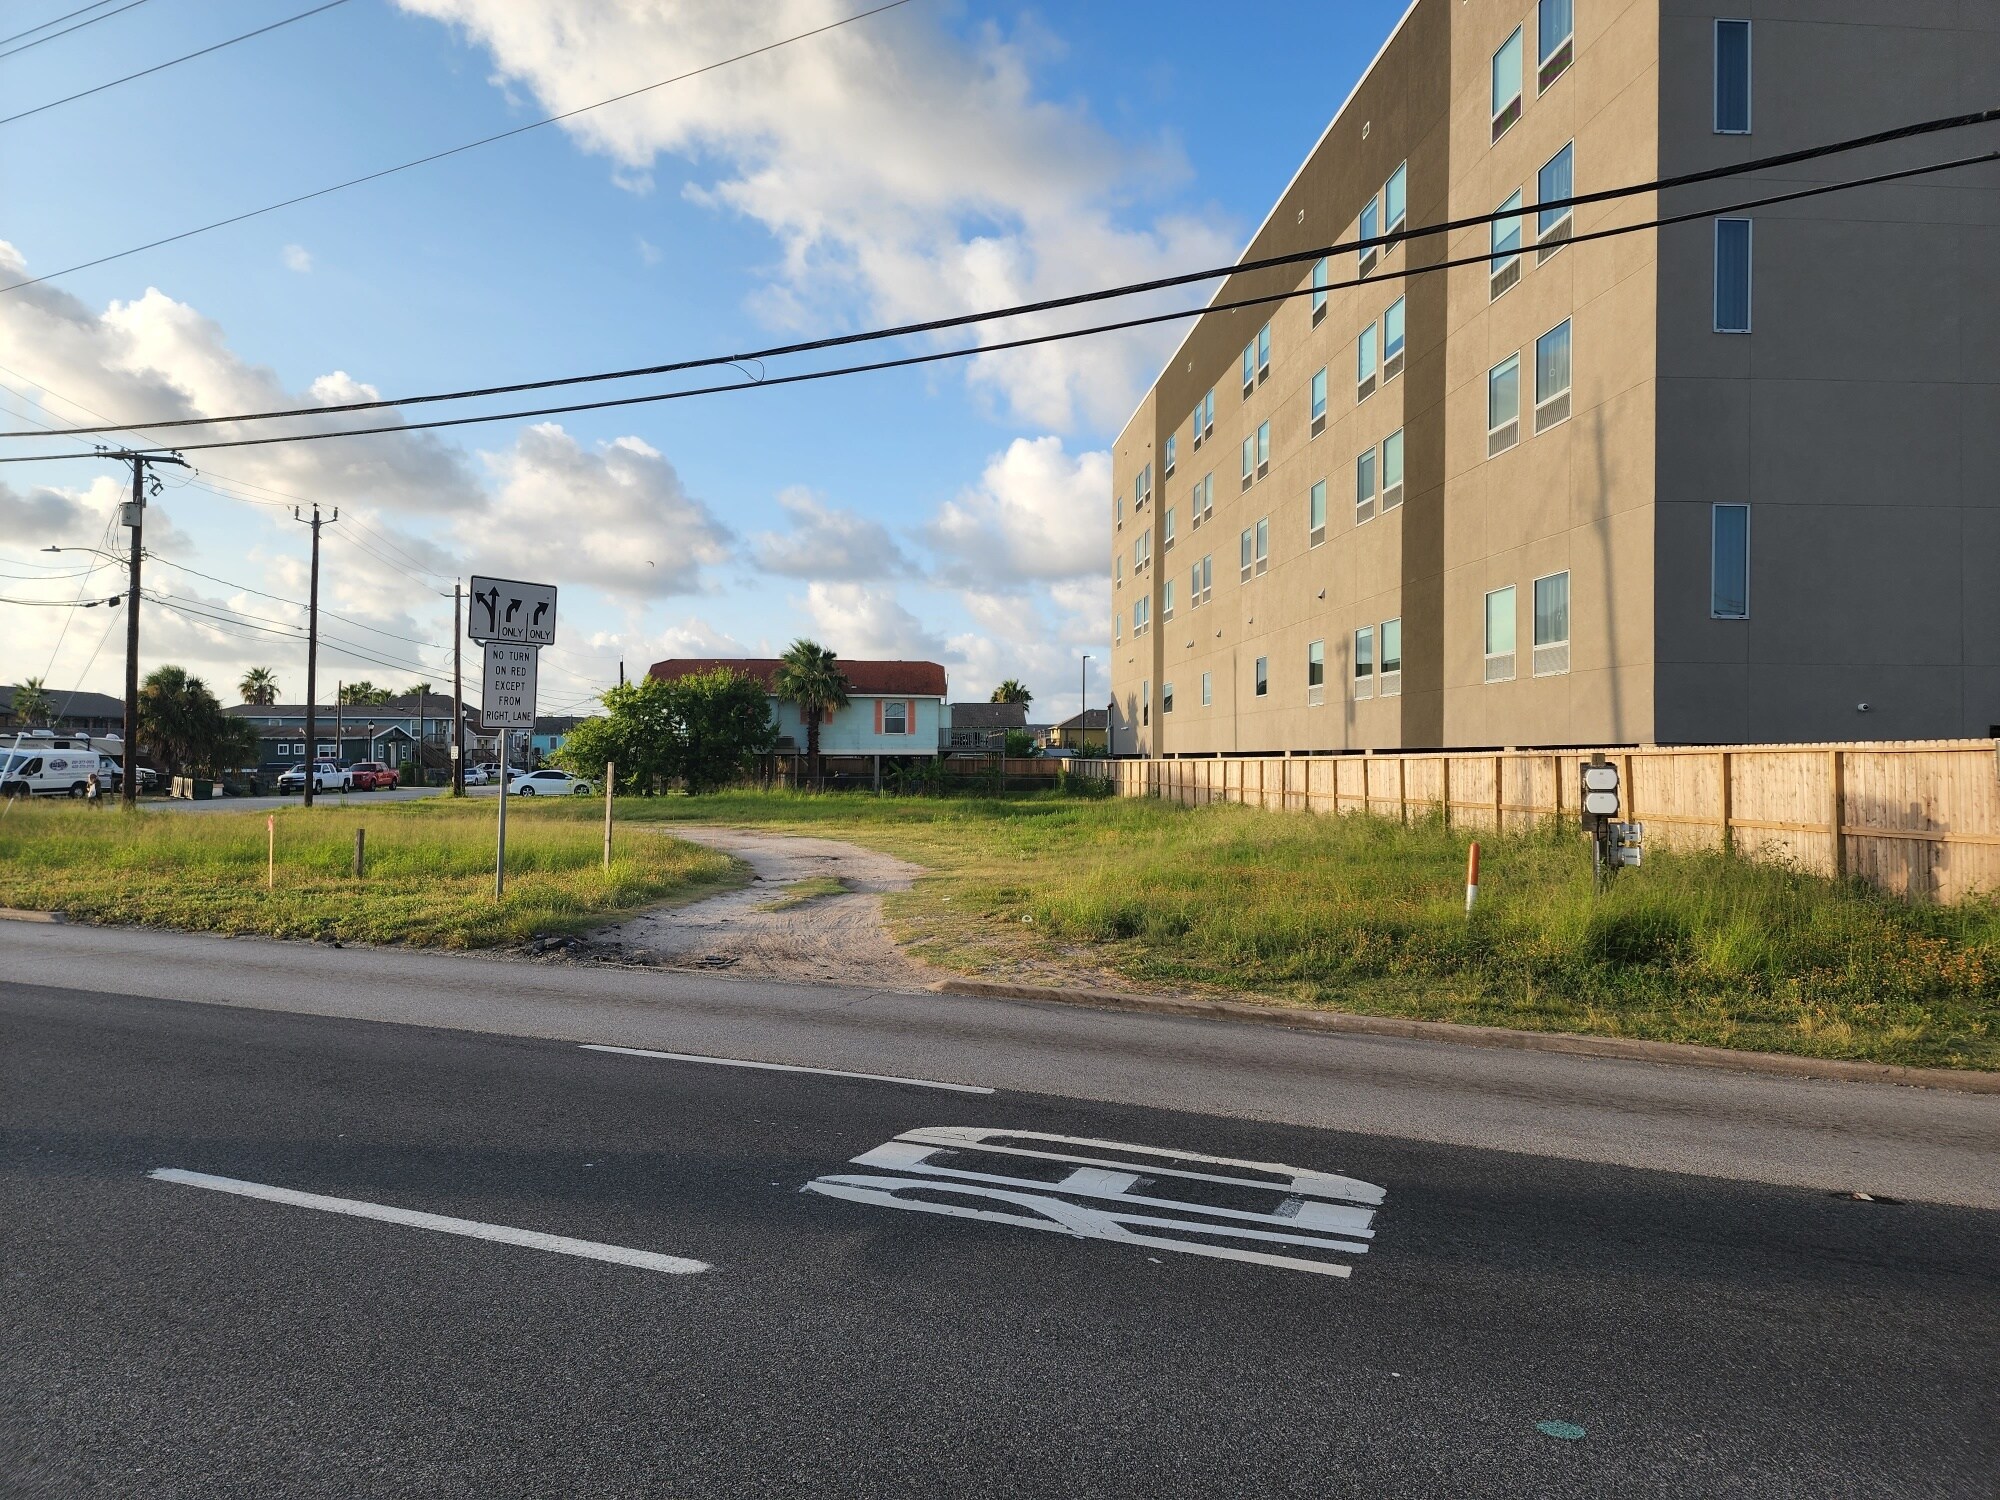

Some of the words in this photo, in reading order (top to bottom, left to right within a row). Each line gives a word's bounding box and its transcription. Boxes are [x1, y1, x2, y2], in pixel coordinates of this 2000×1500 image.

[502, 627, 524, 638] ONLY
[530, 630, 551, 640] ONLY
[493, 650, 504, 659] NO
[510, 651, 529, 662] TURN
[496, 666, 506, 675] ON
[511, 667, 526, 676] RED
[495, 681, 525, 691] EXCEPT
[499, 697, 520, 706] FROM
[487, 711, 508, 720] RIGHT
[513, 712, 531, 721] LANE
